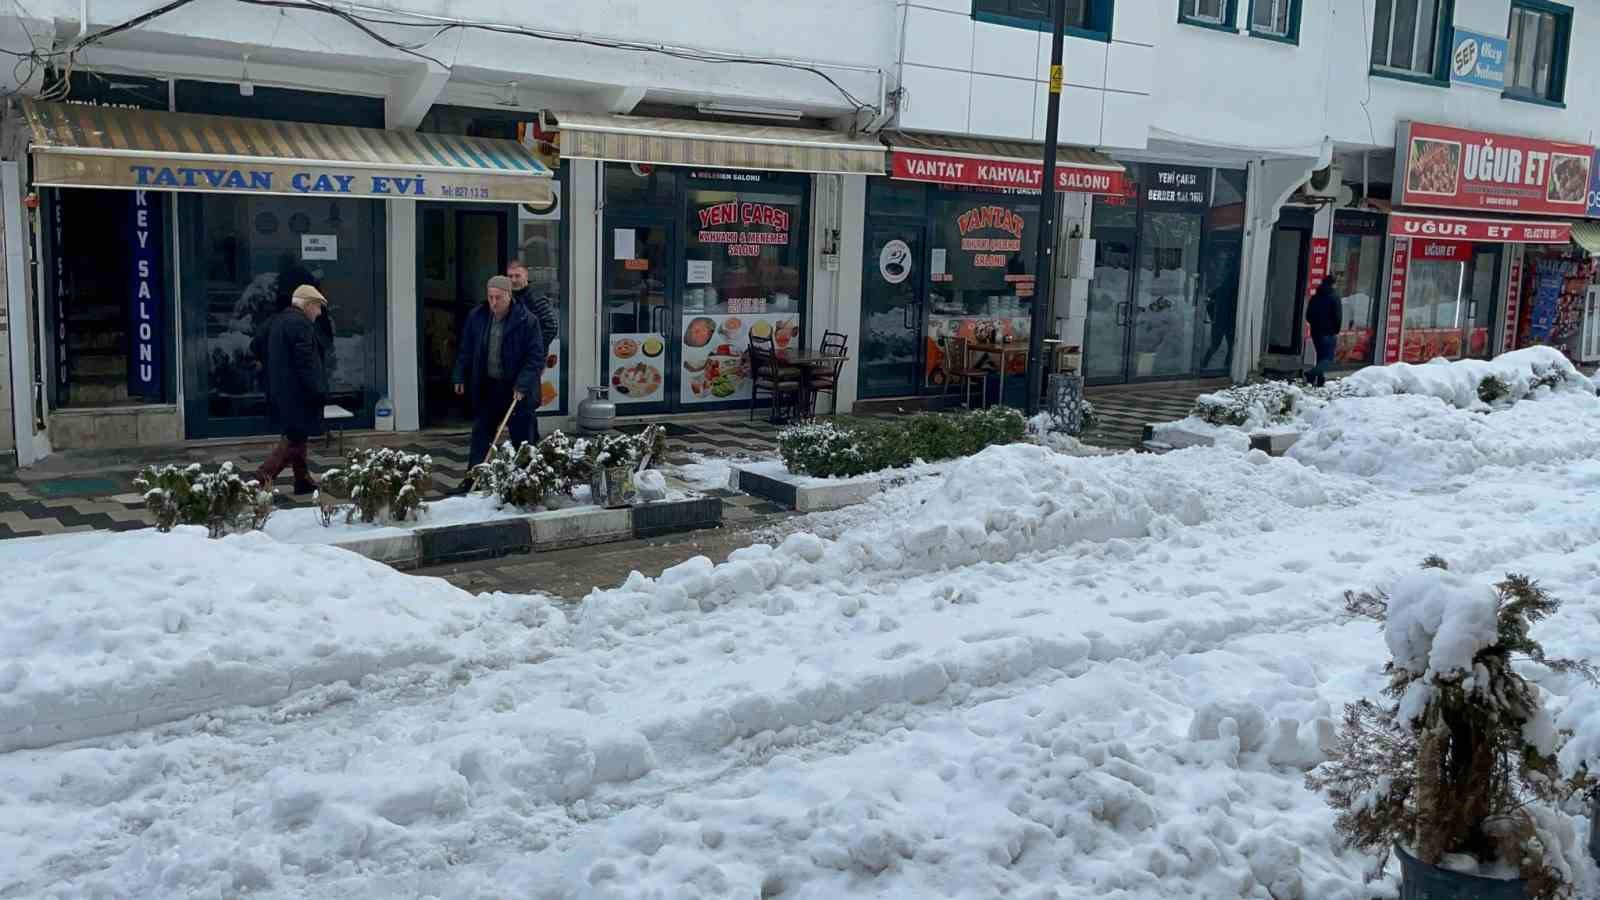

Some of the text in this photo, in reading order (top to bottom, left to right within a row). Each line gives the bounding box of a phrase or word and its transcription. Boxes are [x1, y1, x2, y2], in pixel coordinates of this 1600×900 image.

[906, 158, 1110, 190] VANTAT KAHVALT SALONU
[1463, 137, 1549, 186] UĞUR ET
[129, 165, 273, 190] TATVAN
[291, 172, 355, 193] ÇAY
[371, 174, 427, 195] EVİ
[957, 205, 1025, 239] VANTAT
[1404, 219, 1469, 236] UĞUR
[1487, 226, 1513, 238] ET
[1446, 245, 1457, 257] ET
[138, 260, 152, 382] SALONU
